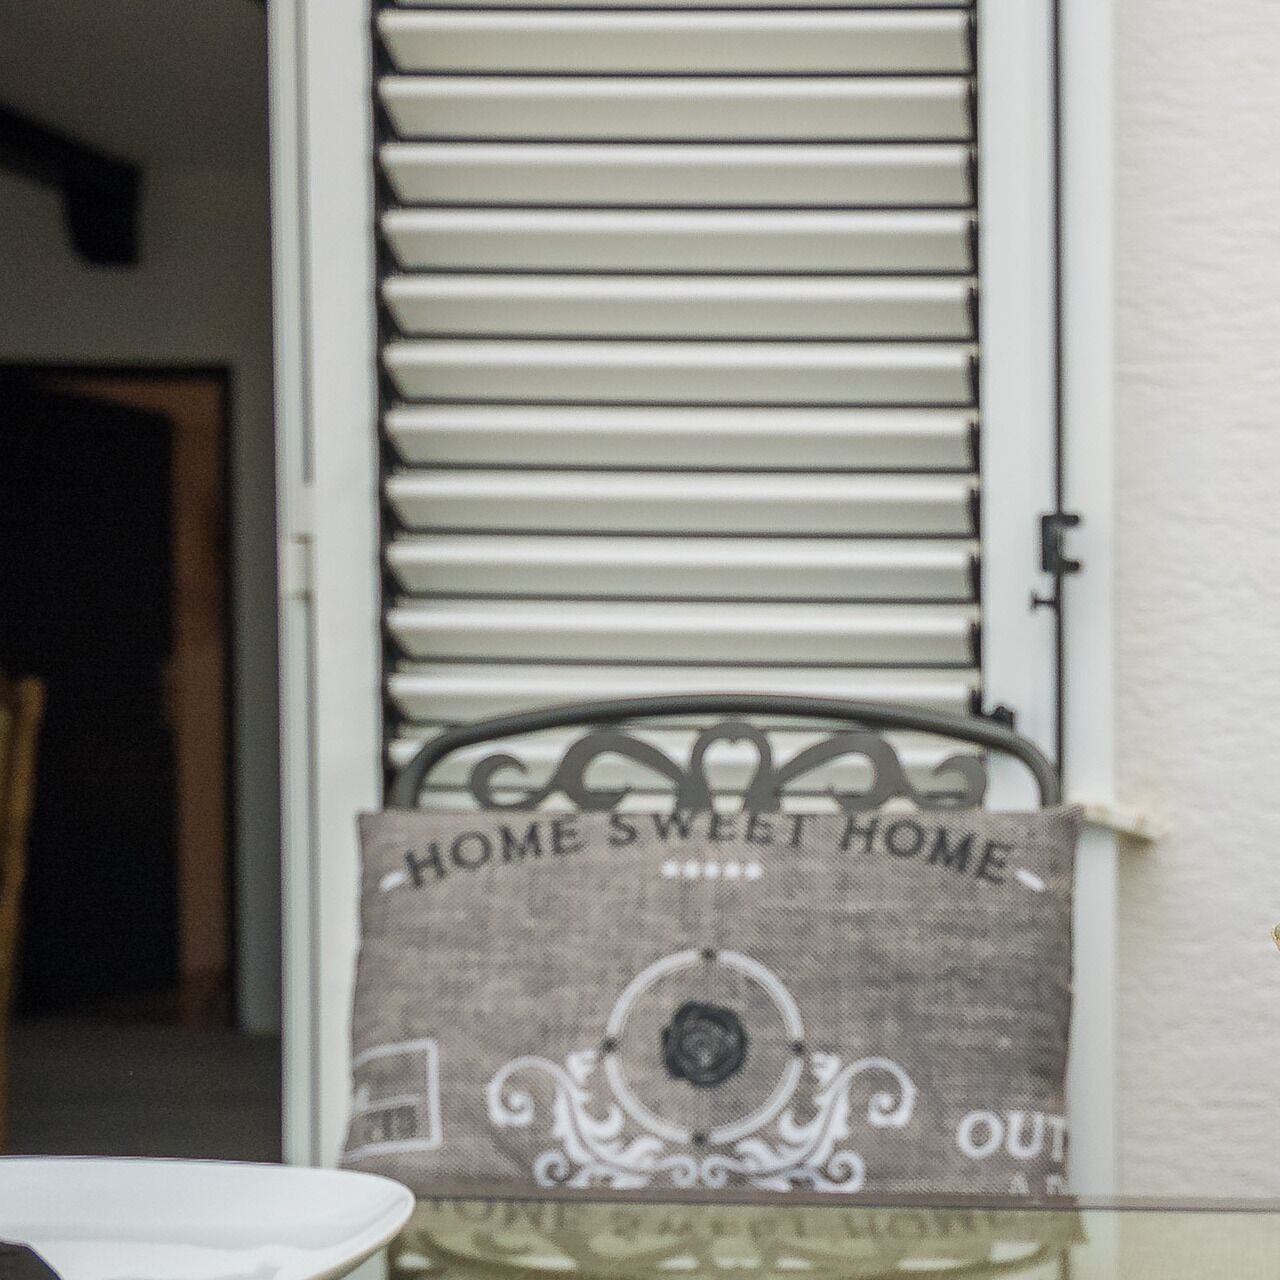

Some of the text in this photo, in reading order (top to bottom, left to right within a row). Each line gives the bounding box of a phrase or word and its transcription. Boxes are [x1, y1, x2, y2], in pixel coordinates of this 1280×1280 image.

[403, 809, 1015, 889] HOME SWEET HOME
